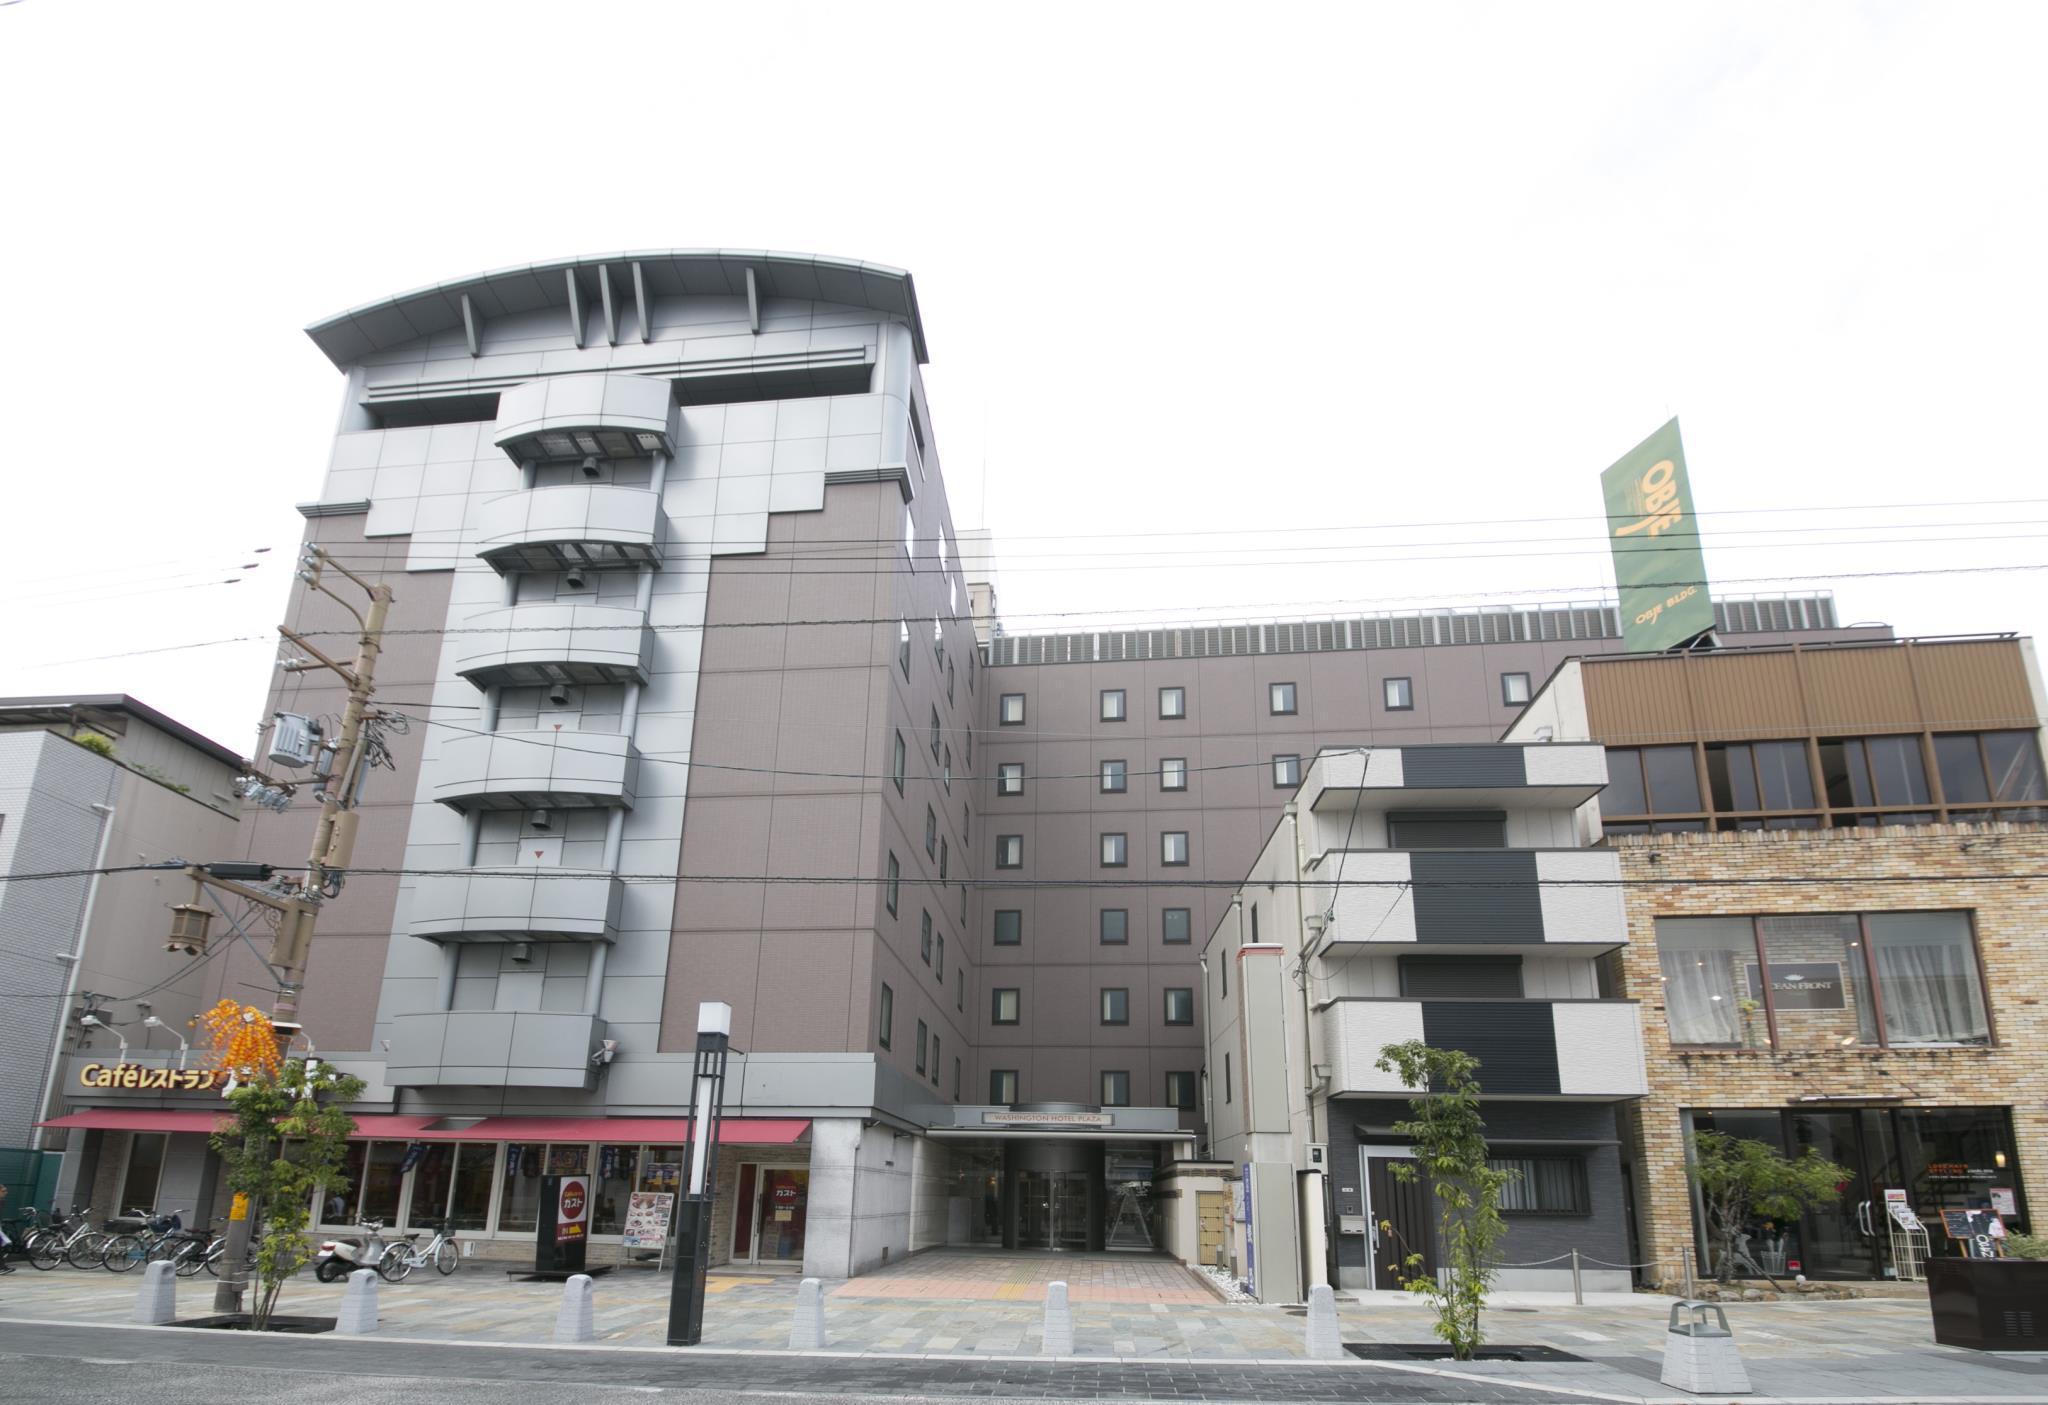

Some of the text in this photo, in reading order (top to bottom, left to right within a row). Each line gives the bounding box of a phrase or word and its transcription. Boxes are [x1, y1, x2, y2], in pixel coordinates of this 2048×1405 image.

[1615, 460, 1682, 540] OBJE
[1798, 982, 1832, 990] FRONT
[994, 1114, 1049, 1122] WASHINGTON
[1079, 1115, 1102, 1123] PLAZA
[563, 1198, 583, 1209] ガスト
